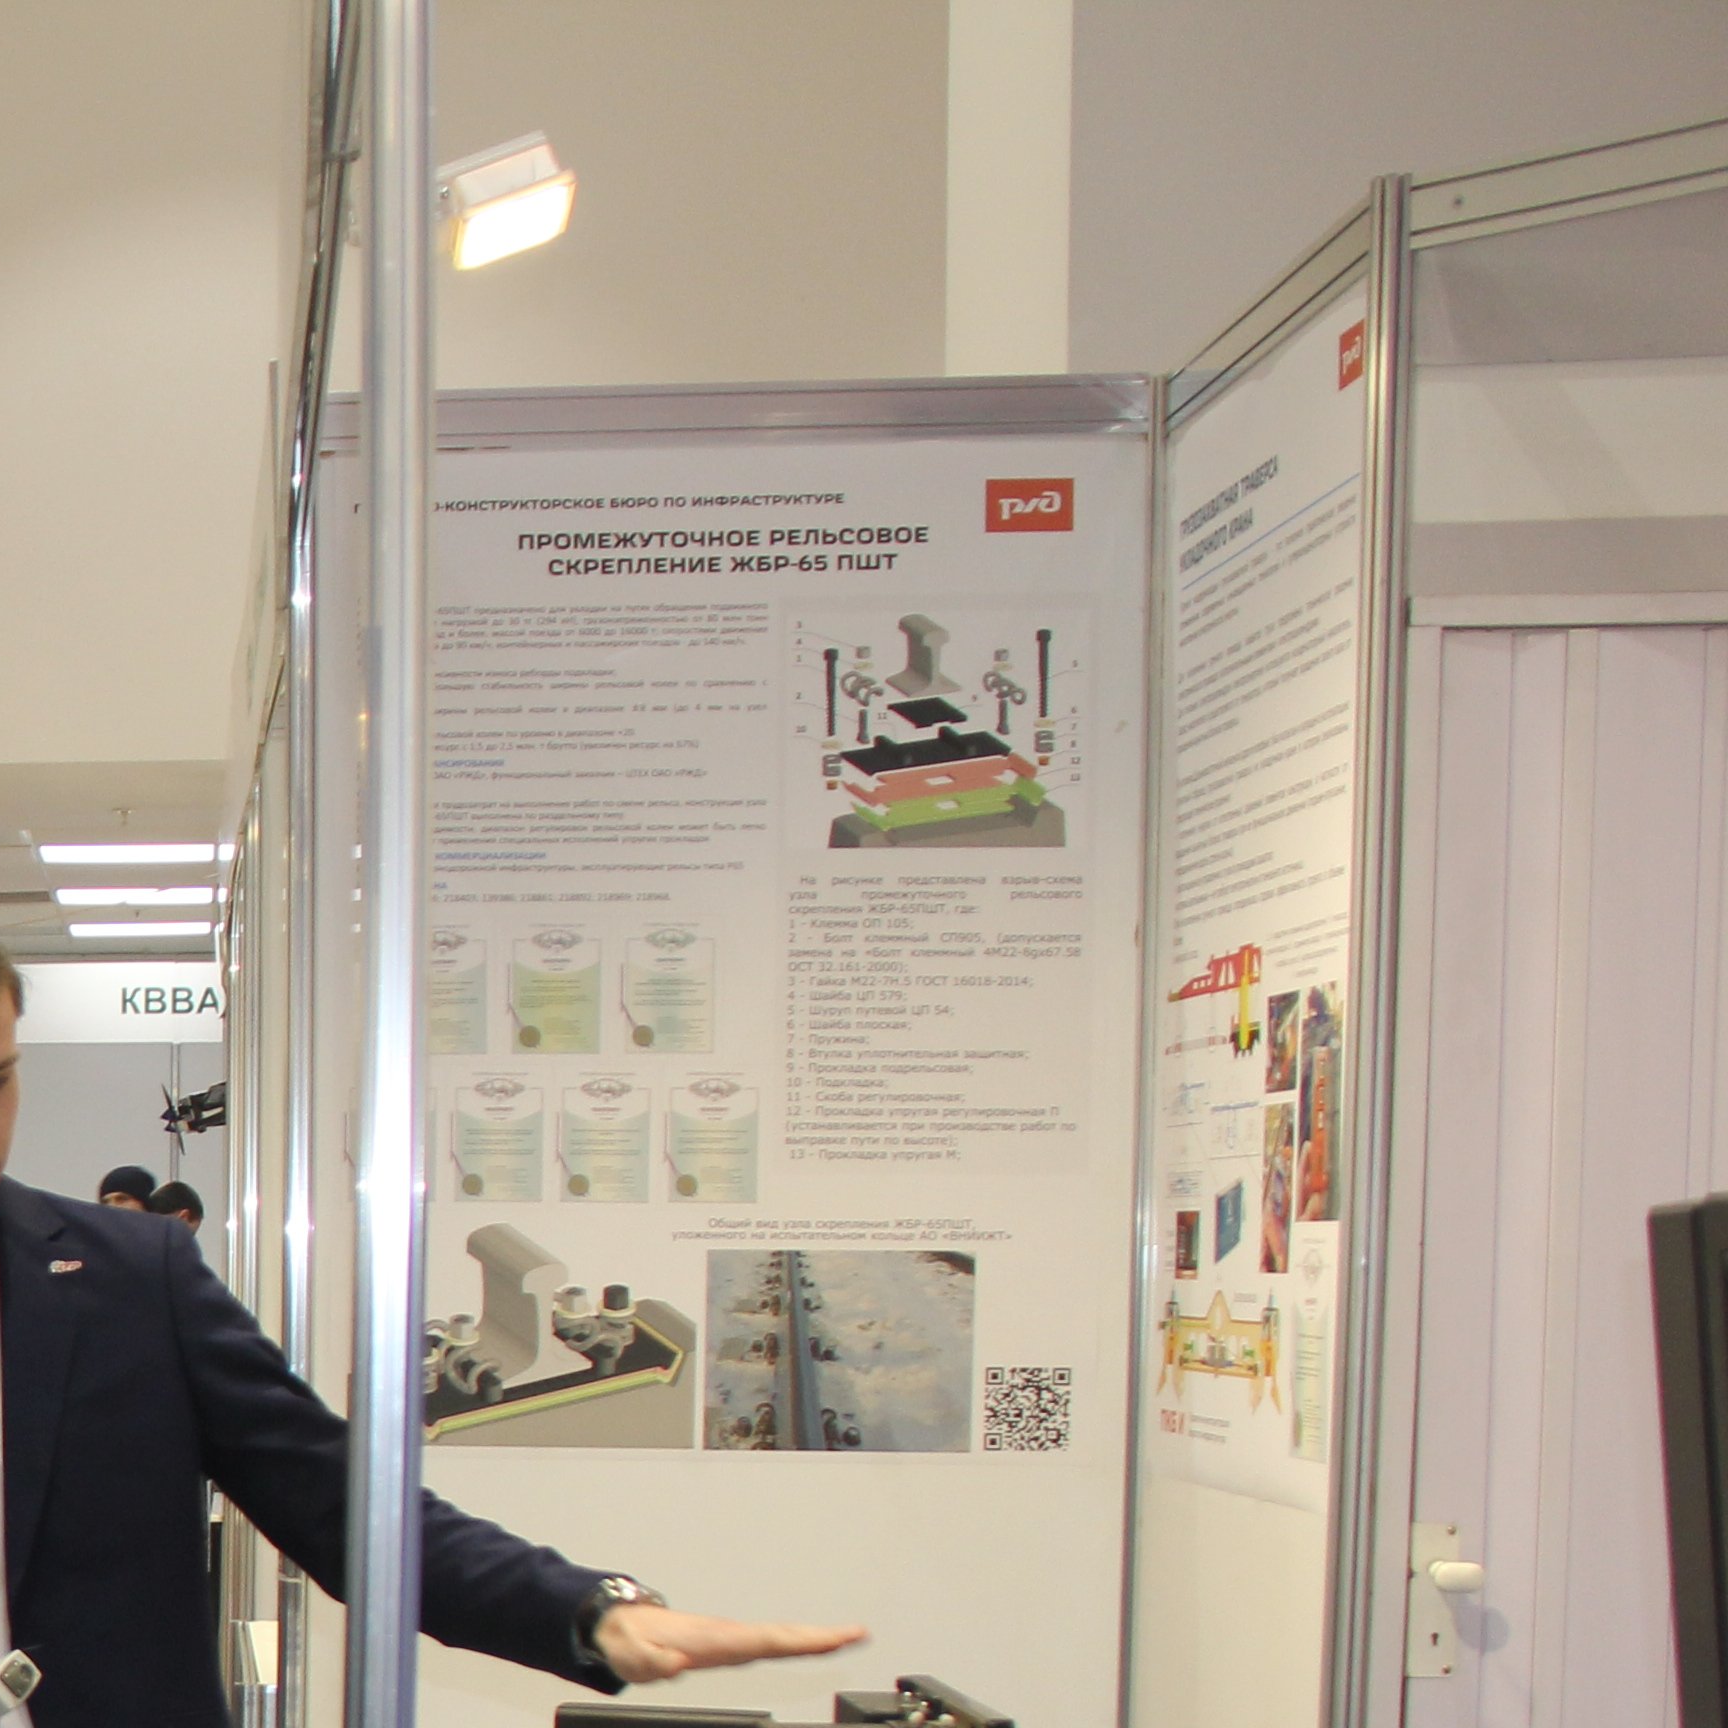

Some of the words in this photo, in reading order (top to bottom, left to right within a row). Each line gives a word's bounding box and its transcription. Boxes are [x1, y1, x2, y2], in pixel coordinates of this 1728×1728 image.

[610, 496, 658, 509] БЮРО
[665, 496, 686, 508] ПО
[691, 493, 844, 507] ИНФРАСТРУКТУРЕ
[518, 530, 759, 551] ПРОМЕЖУТОЧНОЕ
[770, 527, 929, 546] РЕЛЬСОВОЕ
[548, 556, 721, 576] СКРЕПЛЕНИЕ
[730, 555, 828, 574] ЖБР-65
[838, 553, 897, 571] ПШТ
[811, 919, 858, 929] Клемма
[824, 933, 853, 944] Болт
[810, 976, 846, 987] Гайка
[916, 976, 947, 987] ГОСТ
[810, 991, 851, 1002] Шайба
[809, 1020, 851, 1031] Шайба
[809, 1049, 851, 1060] Втулка
[809, 1063, 876, 1075] Прокладка
[816, 1092, 853, 1104] Скоба
[816, 1106, 883, 1118] Прокладка
[819, 1150, 887, 1161] Прокладка
[709, 1217, 751, 1230] Общий
[816, 1217, 889, 1230] скрепления
[672, 1230, 746, 1242] уложенного
[770, 1230, 866, 1242] испытательном
